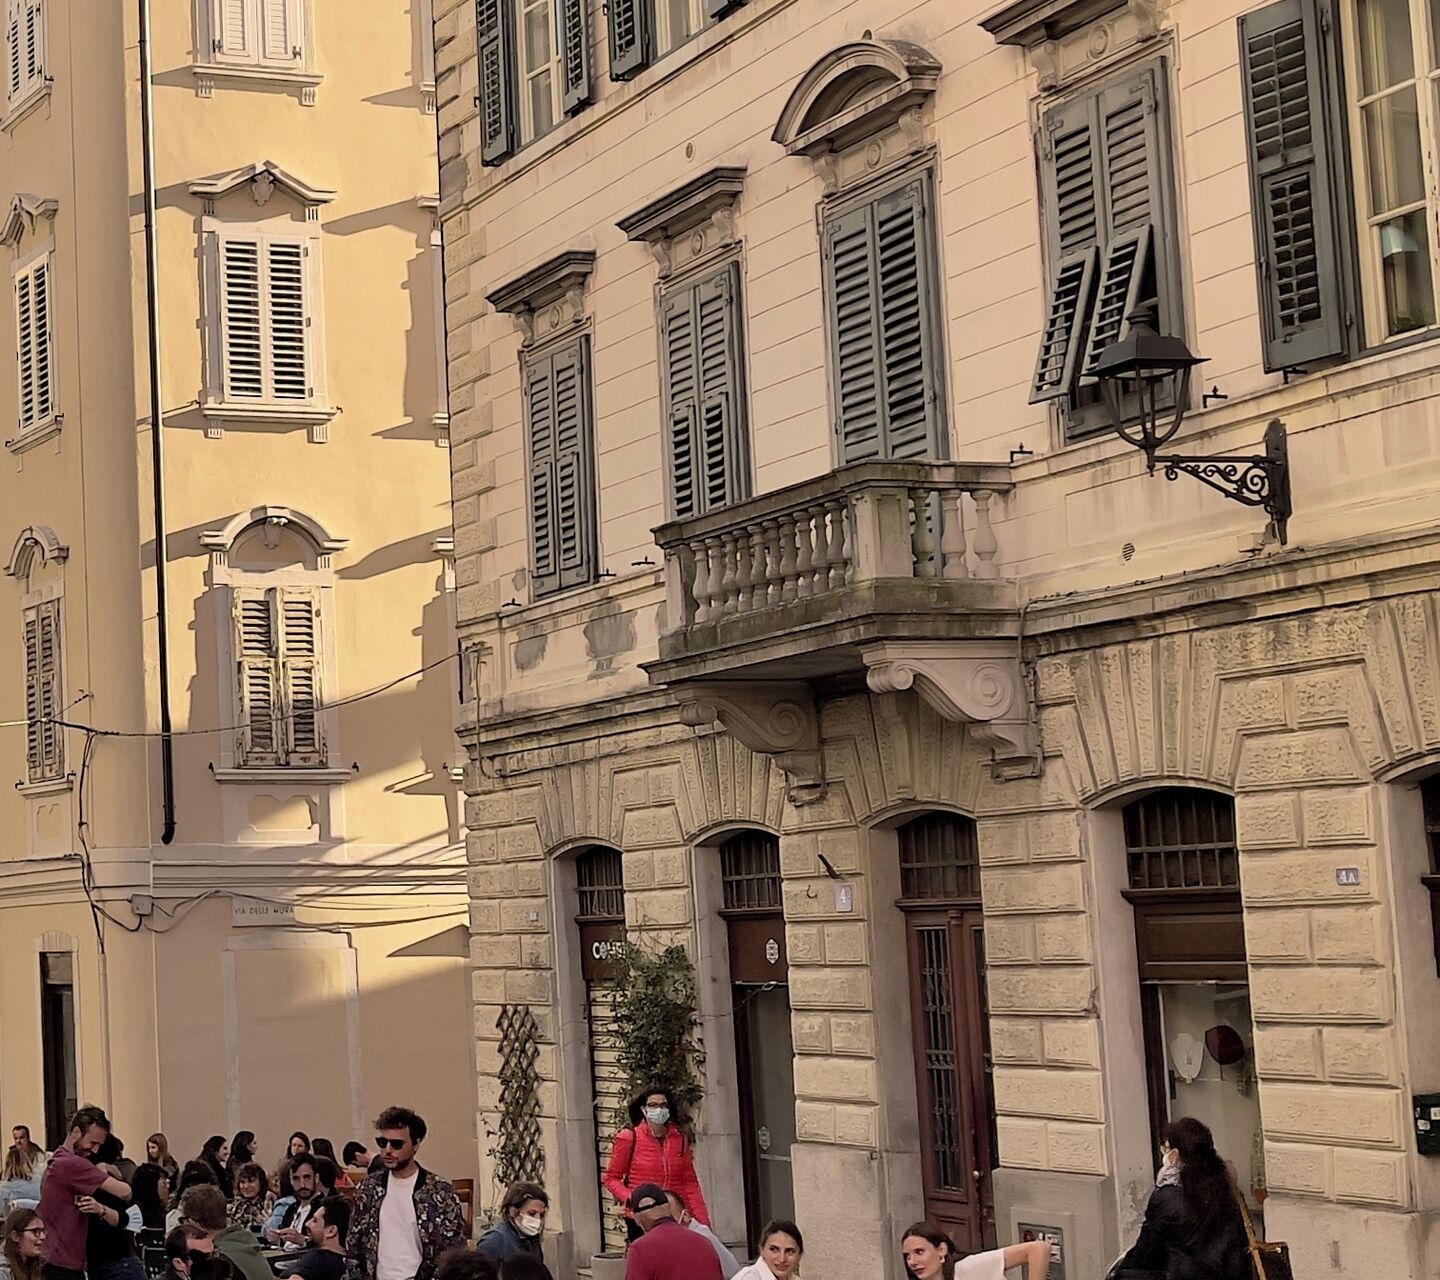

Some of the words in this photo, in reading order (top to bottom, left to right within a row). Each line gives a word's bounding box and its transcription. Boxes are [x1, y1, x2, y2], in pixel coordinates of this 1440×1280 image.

[234, 906, 246, 915] VIA
[249, 906, 269, 915] DELLE
[273, 906, 294, 915] MURA
